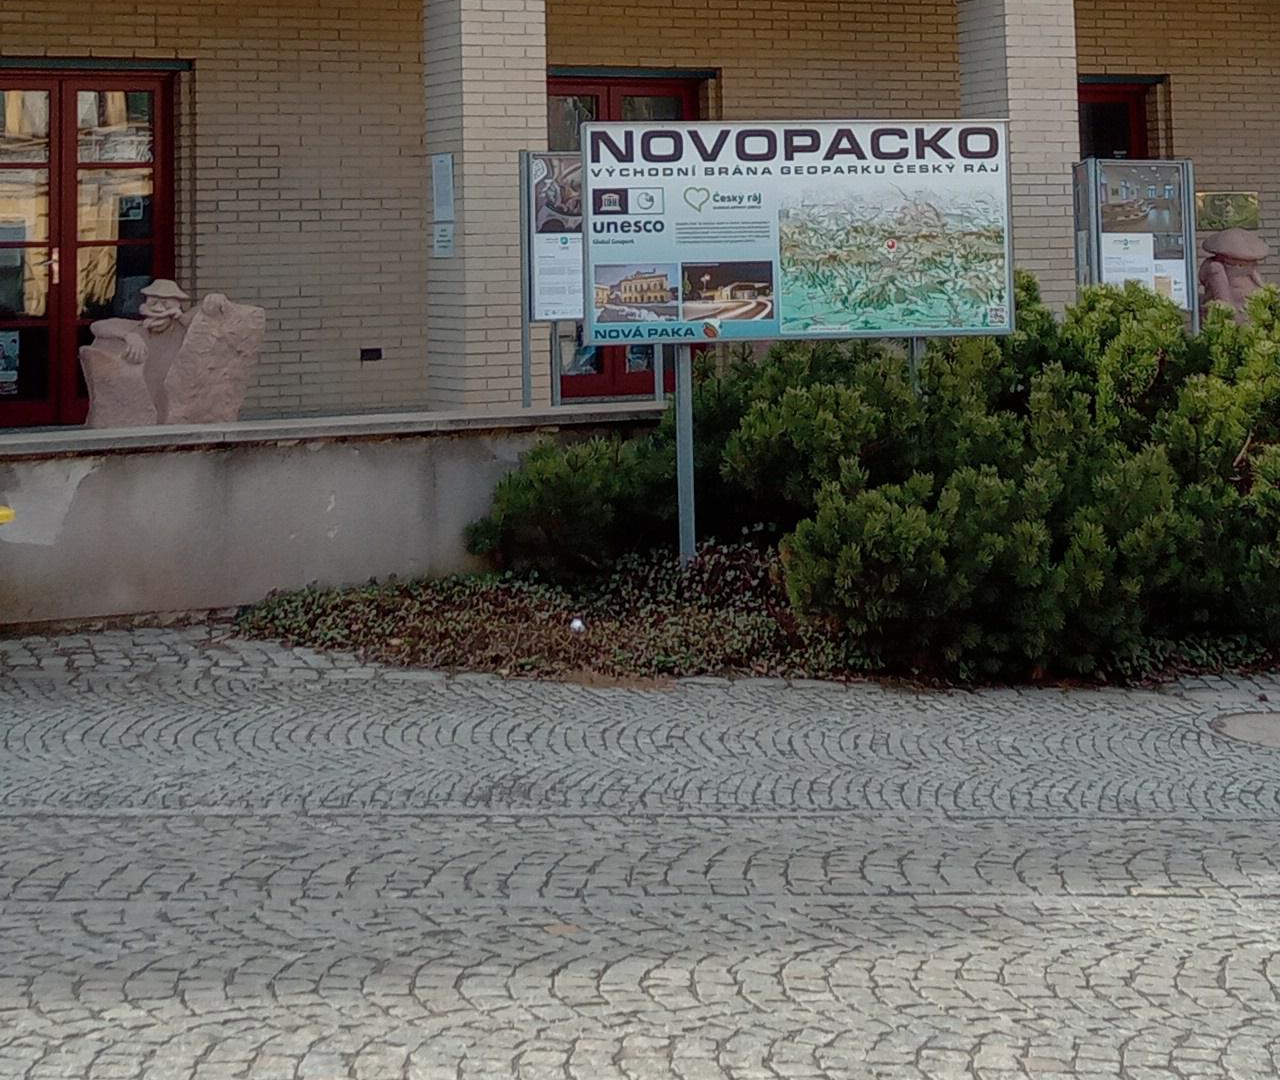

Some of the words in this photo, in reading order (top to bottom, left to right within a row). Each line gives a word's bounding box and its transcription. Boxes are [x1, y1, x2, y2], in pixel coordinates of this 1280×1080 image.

[590, 126, 1000, 164] NOVOPACKO
[590, 165, 697, 178] VÝCHODNÍ
[704, 164, 773, 176] BRÁNA
[780, 164, 886, 176] GEOPARKU
[892, 161, 956, 174] ČESKÝ
[963, 162, 1000, 173] RÁJ
[712, 191, 745, 205] Český
[747, 192, 762, 205] ráj
[592, 219, 665, 234] unesco
[594, 325, 647, 339] NOVÁ
[647, 326, 696, 338] PAKA
